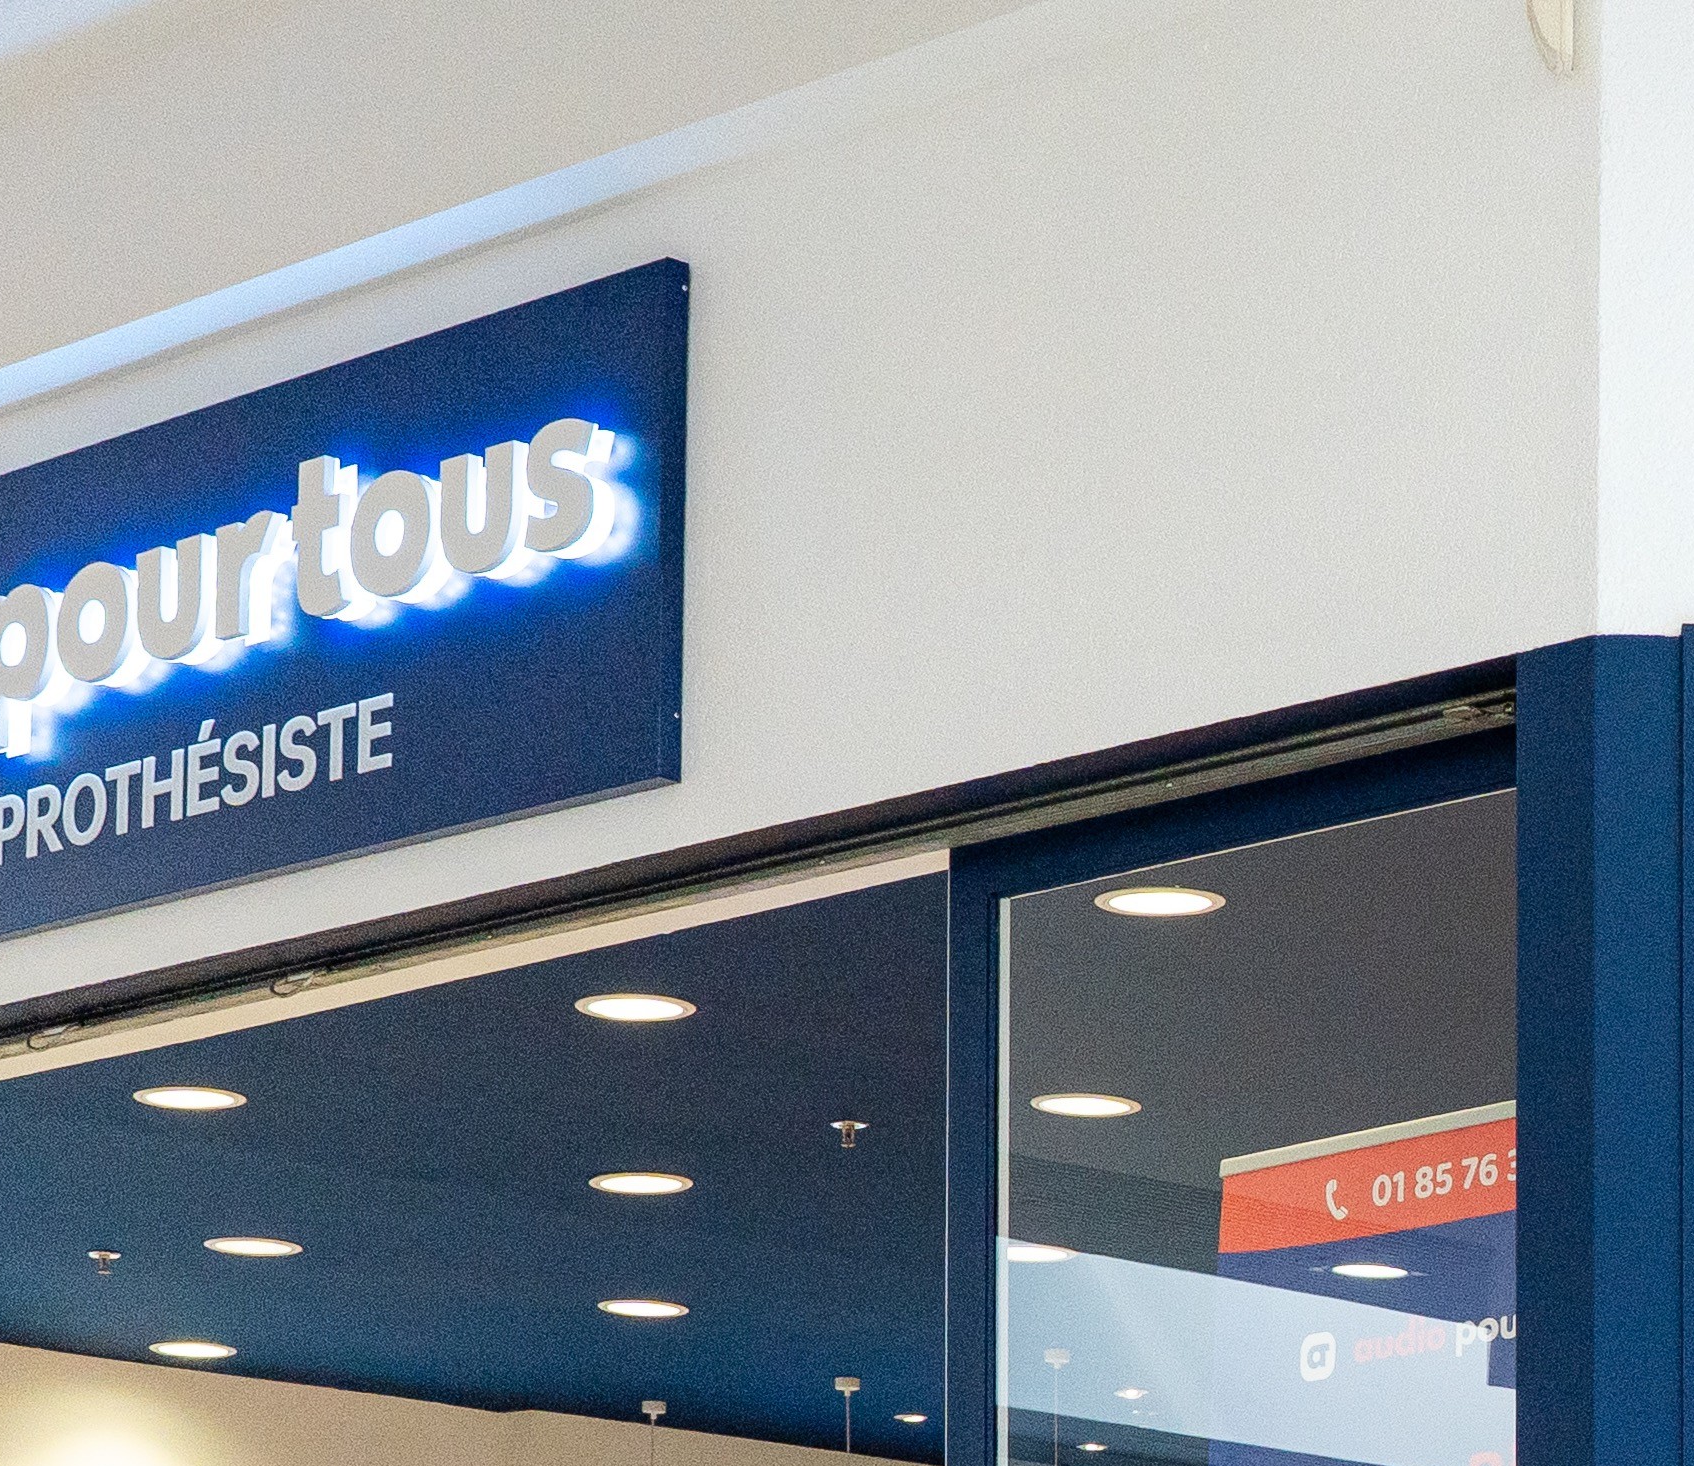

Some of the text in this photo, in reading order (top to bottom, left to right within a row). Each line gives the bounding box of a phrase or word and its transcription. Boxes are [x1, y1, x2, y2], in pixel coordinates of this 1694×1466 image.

[294, 416, 606, 620] tous
[1371, 1172, 1407, 1207] 01
[1413, 1161, 1454, 1198] 85
[1461, 1152, 1499, 1190] 76
[1354, 1317, 1446, 1363] audio
